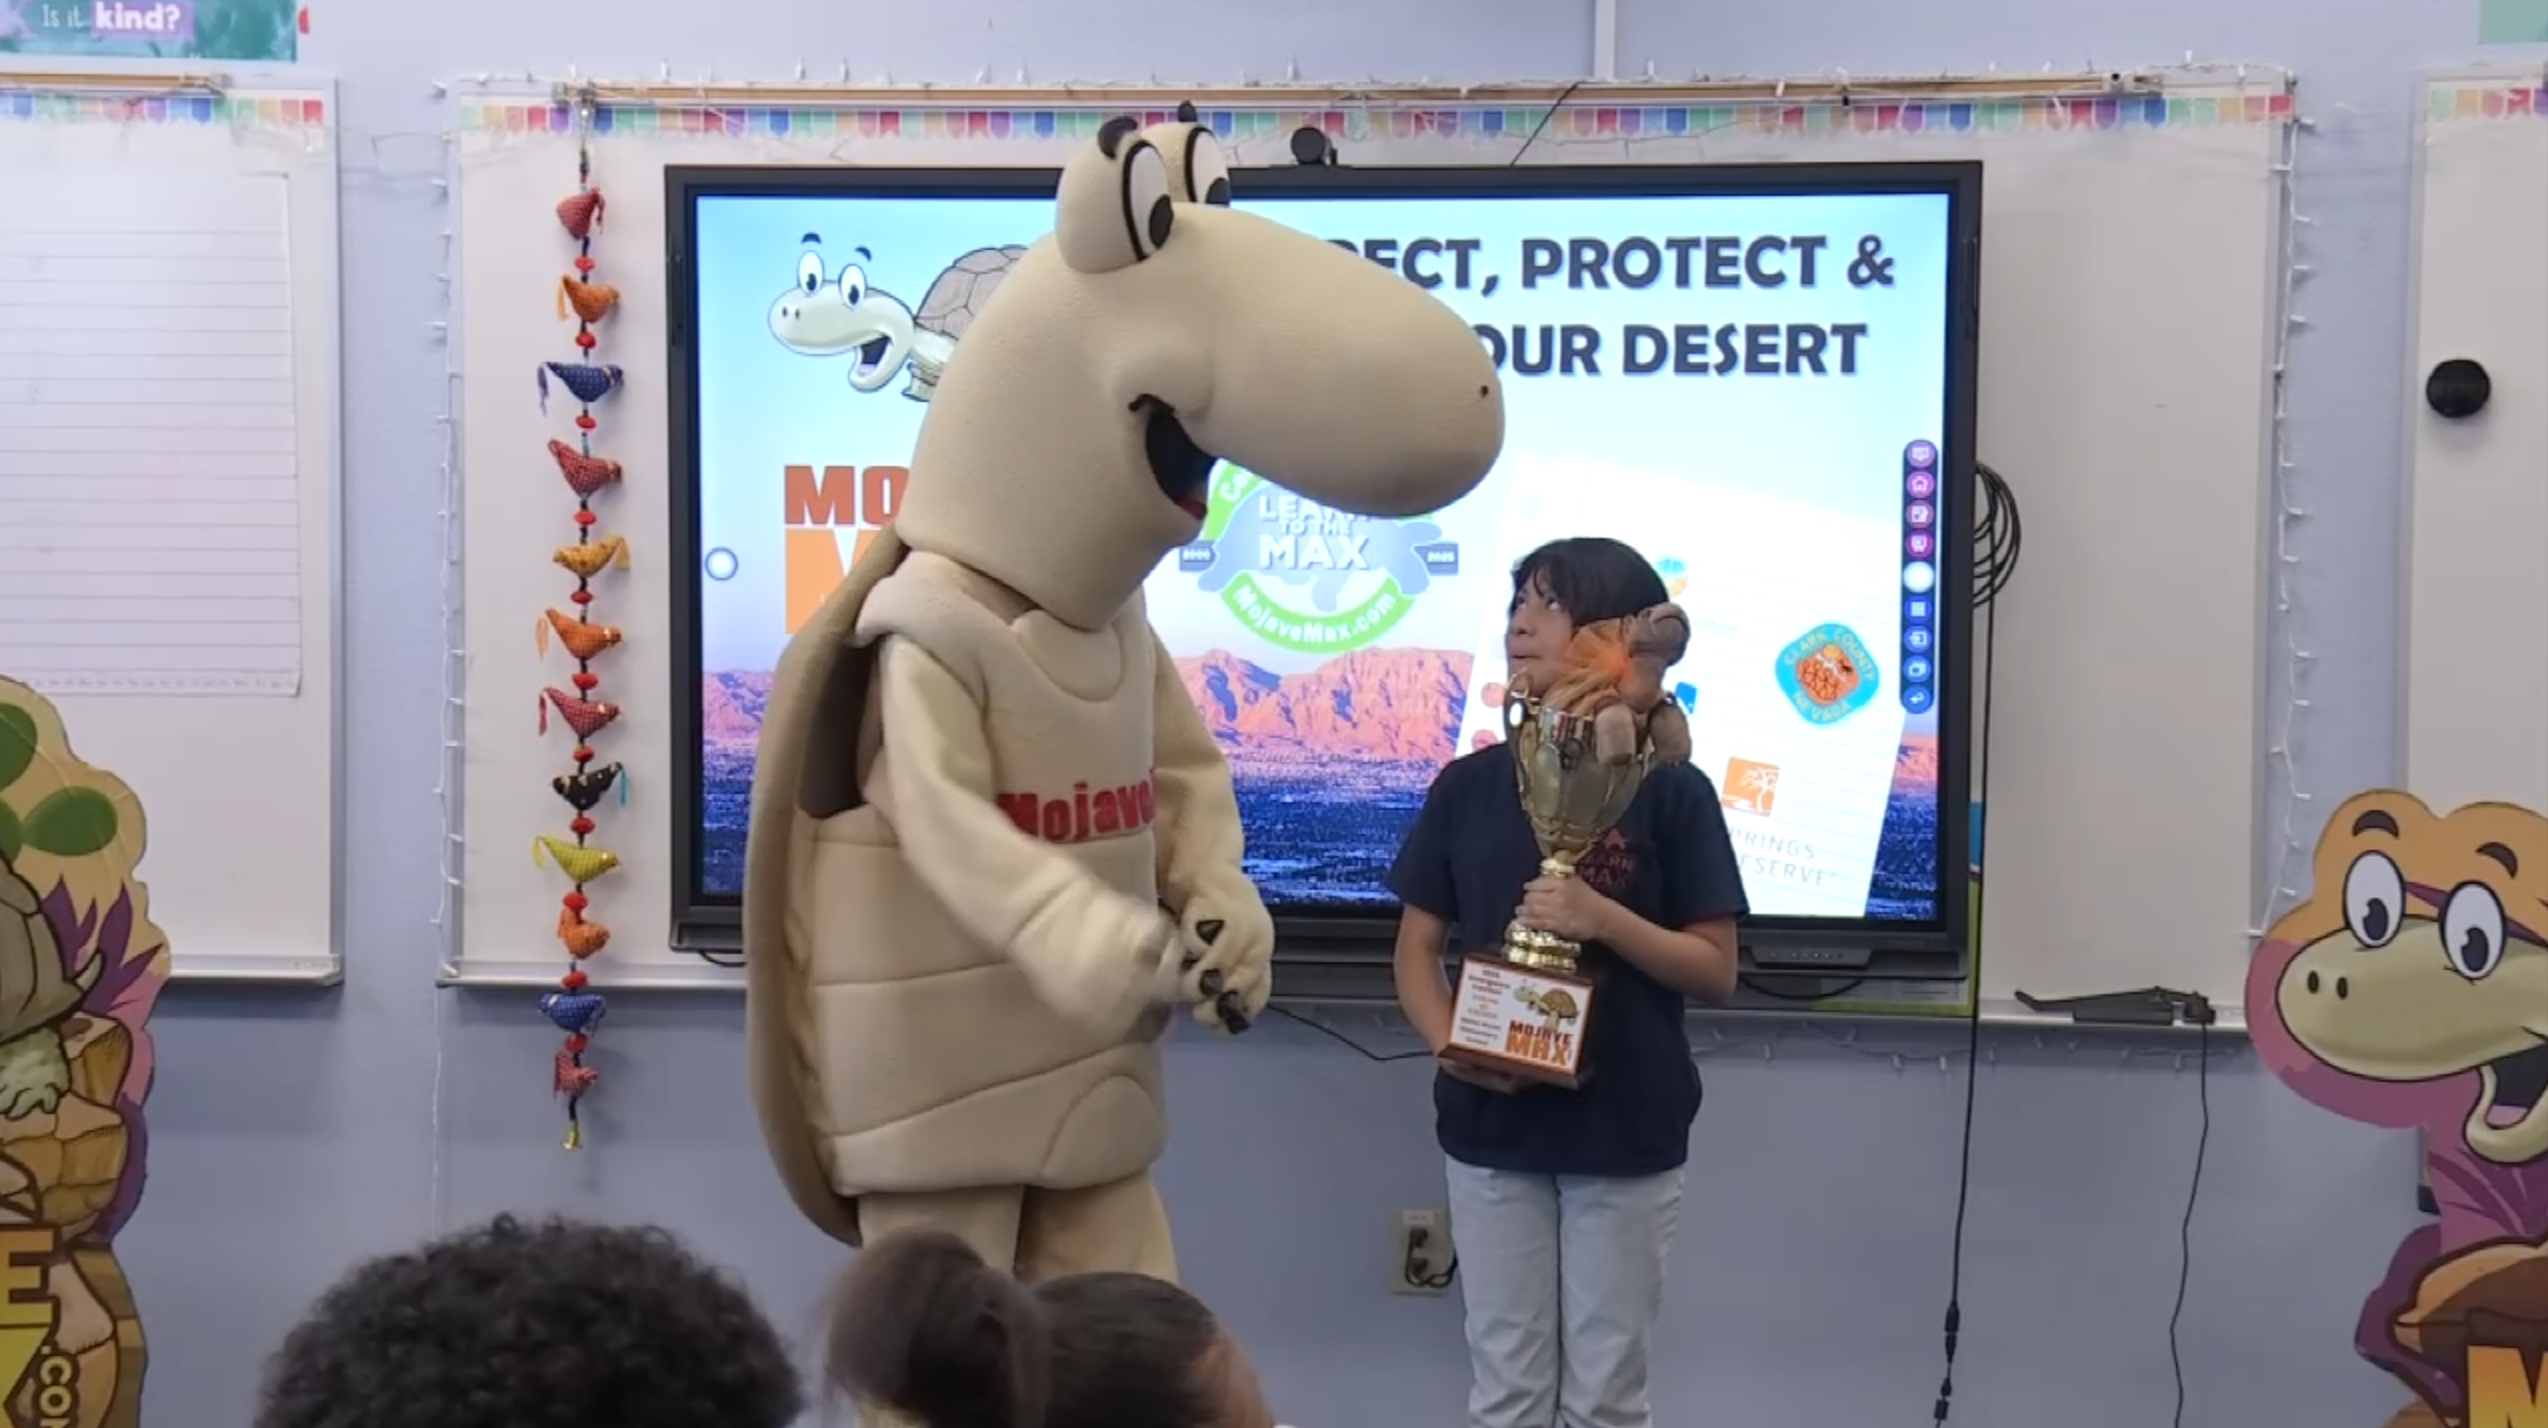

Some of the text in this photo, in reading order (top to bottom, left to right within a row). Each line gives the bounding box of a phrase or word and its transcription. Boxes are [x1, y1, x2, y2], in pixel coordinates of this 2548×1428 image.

[42, 4, 60, 28] Is
[67, 6, 83, 28] it
[95, 1, 181, 31] kind?
[1328, 235, 1895, 297] ECT, PROTECT &
[1622, 323, 1868, 375] DESERT
[785, 465, 909, 526] MO
[1279, 520, 1351, 535] TO THE
[1259, 534, 1370, 571] MAX
[1233, 585, 1397, 644] MojaveMax.com
[1729, 826, 1816, 861] PRINGS
[1740, 852, 1828, 888] ESERVE
[1505, 1032, 1568, 1067] MAX
